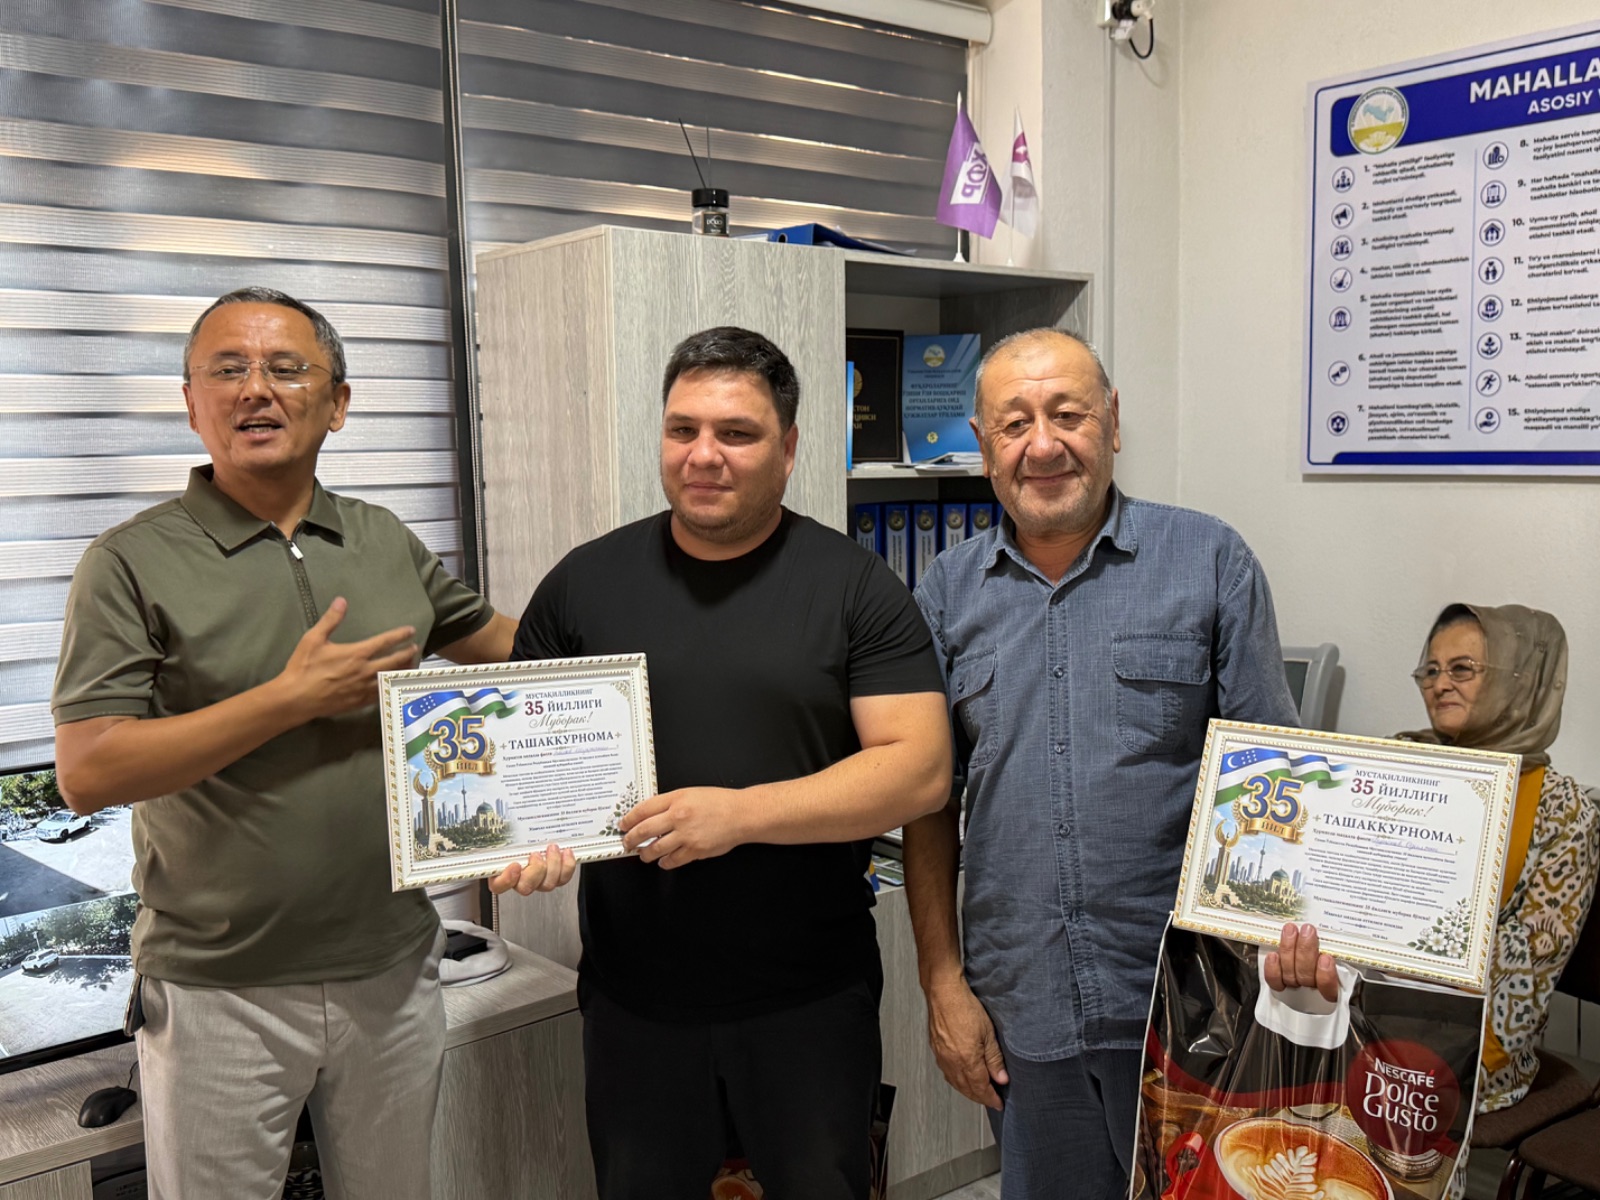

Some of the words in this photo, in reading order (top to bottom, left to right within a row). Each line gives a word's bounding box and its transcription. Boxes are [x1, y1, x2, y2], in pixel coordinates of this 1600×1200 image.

[1469, 57, 1600, 103] MAHALLA
[1528, 89, 1592, 115] ASOSIY
[1518, 179, 1526, 187] 9.
[1512, 218, 1525, 226] 10.
[1511, 298, 1522, 306] 12.
[1510, 332, 1522, 340] 13.
[1508, 374, 1521, 382] 14.
[1508, 407, 1519, 416] 15.
[524, 701, 543, 716] 35
[547, 699, 602, 713] ЙИЛЛИГИ
[528, 711, 594, 730] Муборак!
[429, 715, 487, 764] 35
[508, 731, 614, 750] ТАШАККУРНОМА
[1239, 773, 1304, 824] 35
[1350, 777, 1374, 795] 35
[1378, 784, 1448, 804] ЙИЛЛИГИ
[1351, 796, 1433, 818] Муборак!
[1323, 813, 1454, 844] ТАШАККУРНОМА
[1375, 1057, 1435, 1088] NESCAFÉ
[1365, 1071, 1440, 1113] Dolce
[1363, 1095, 1438, 1132] Gusto
